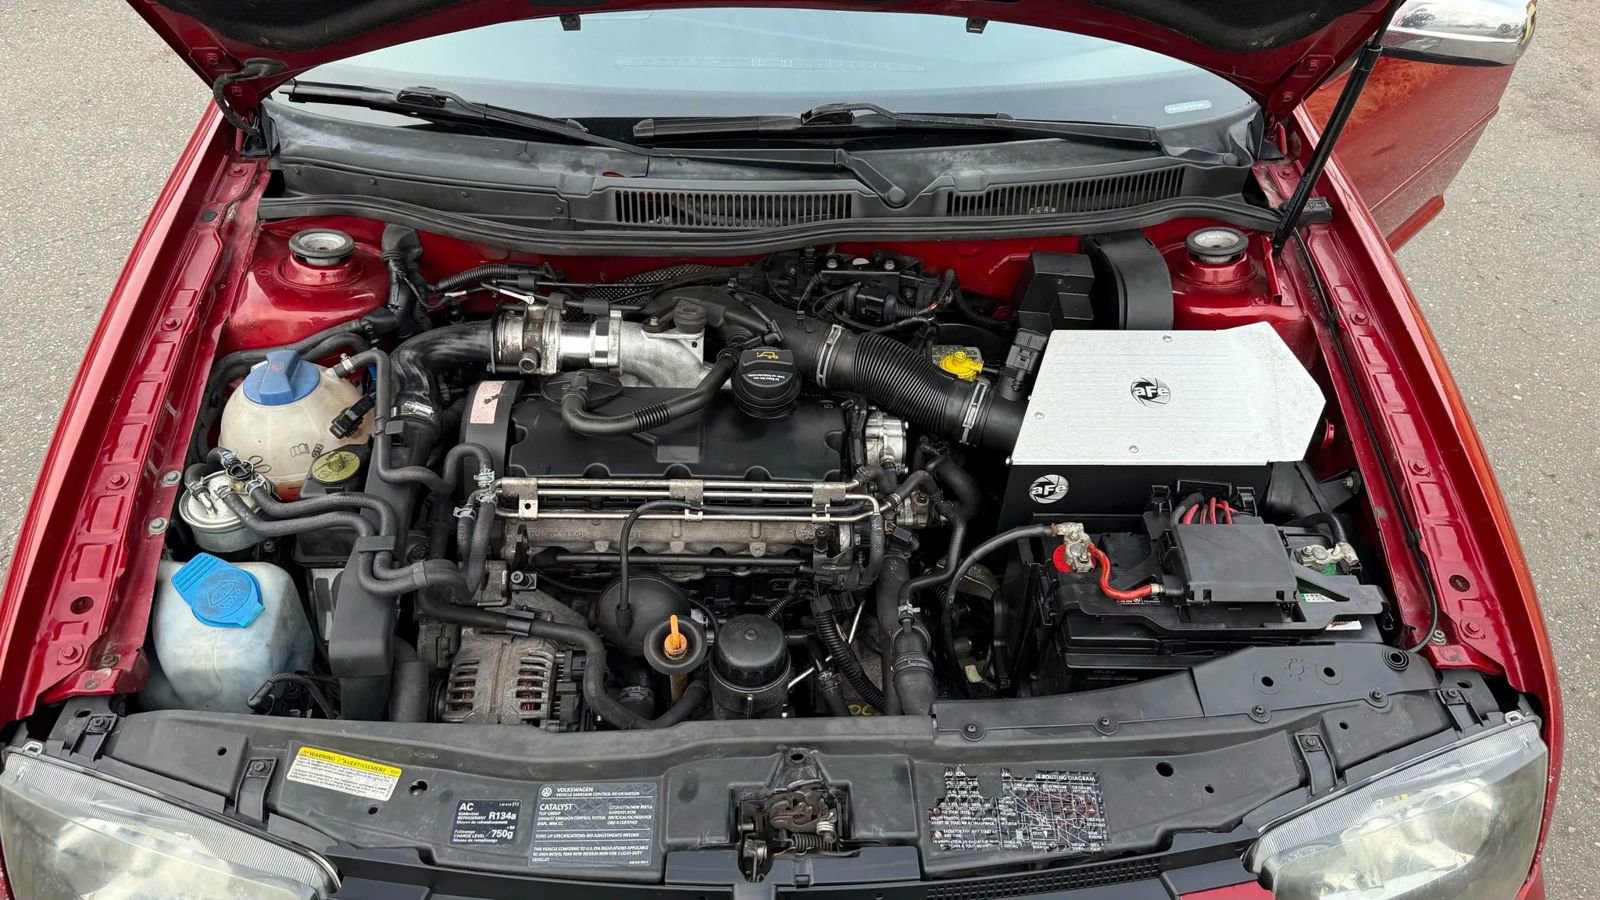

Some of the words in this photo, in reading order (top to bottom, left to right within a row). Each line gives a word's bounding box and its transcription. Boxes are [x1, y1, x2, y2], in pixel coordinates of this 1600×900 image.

[1133, 385, 1169, 398] aFe
[1031, 484, 1067, 496] aFe
[309, 752, 336, 761] WARNING
[459, 802, 474, 811] AC
[488, 812, 516, 820] R134a
[492, 829, 514, 839] 750g
